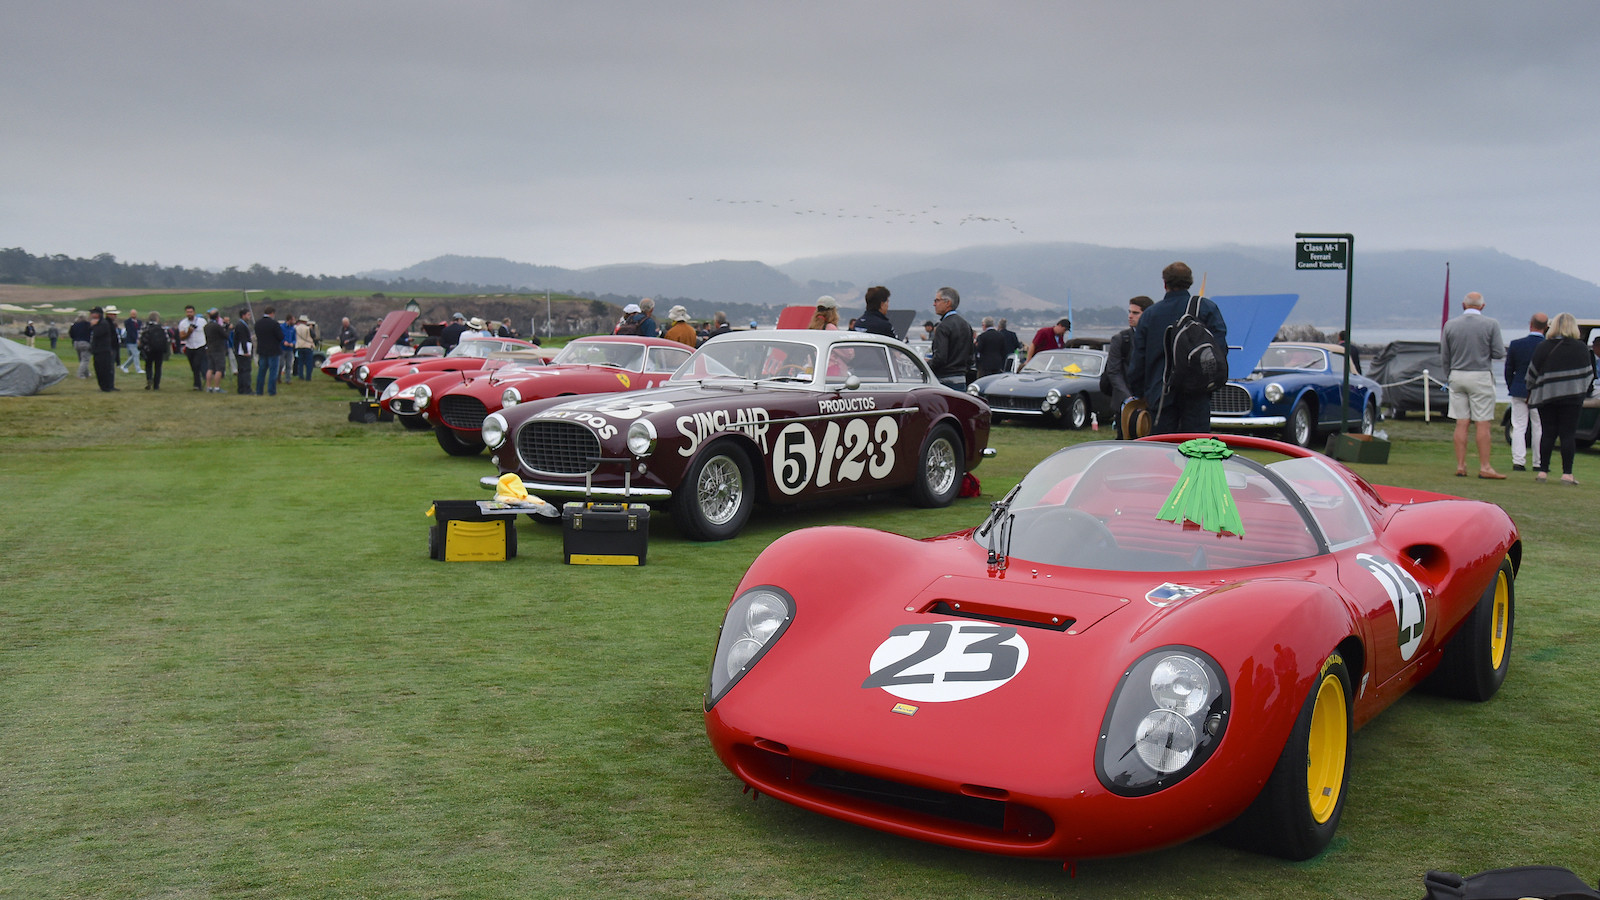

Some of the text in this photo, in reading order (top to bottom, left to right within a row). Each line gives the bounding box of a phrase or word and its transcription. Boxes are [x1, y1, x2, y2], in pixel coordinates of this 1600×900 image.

[1303, 243, 1339, 251] Class M-1
[1310, 252, 1331, 260] Ferrari
[1319, 261, 1343, 269] Touring
[818, 397, 876, 414] PRODUCTOS
[574, 412, 618, 440] DOS
[676, 407, 770, 457] SINCLAIR
[782, 430, 808, 489] 5
[861, 623, 1020, 689] 23
